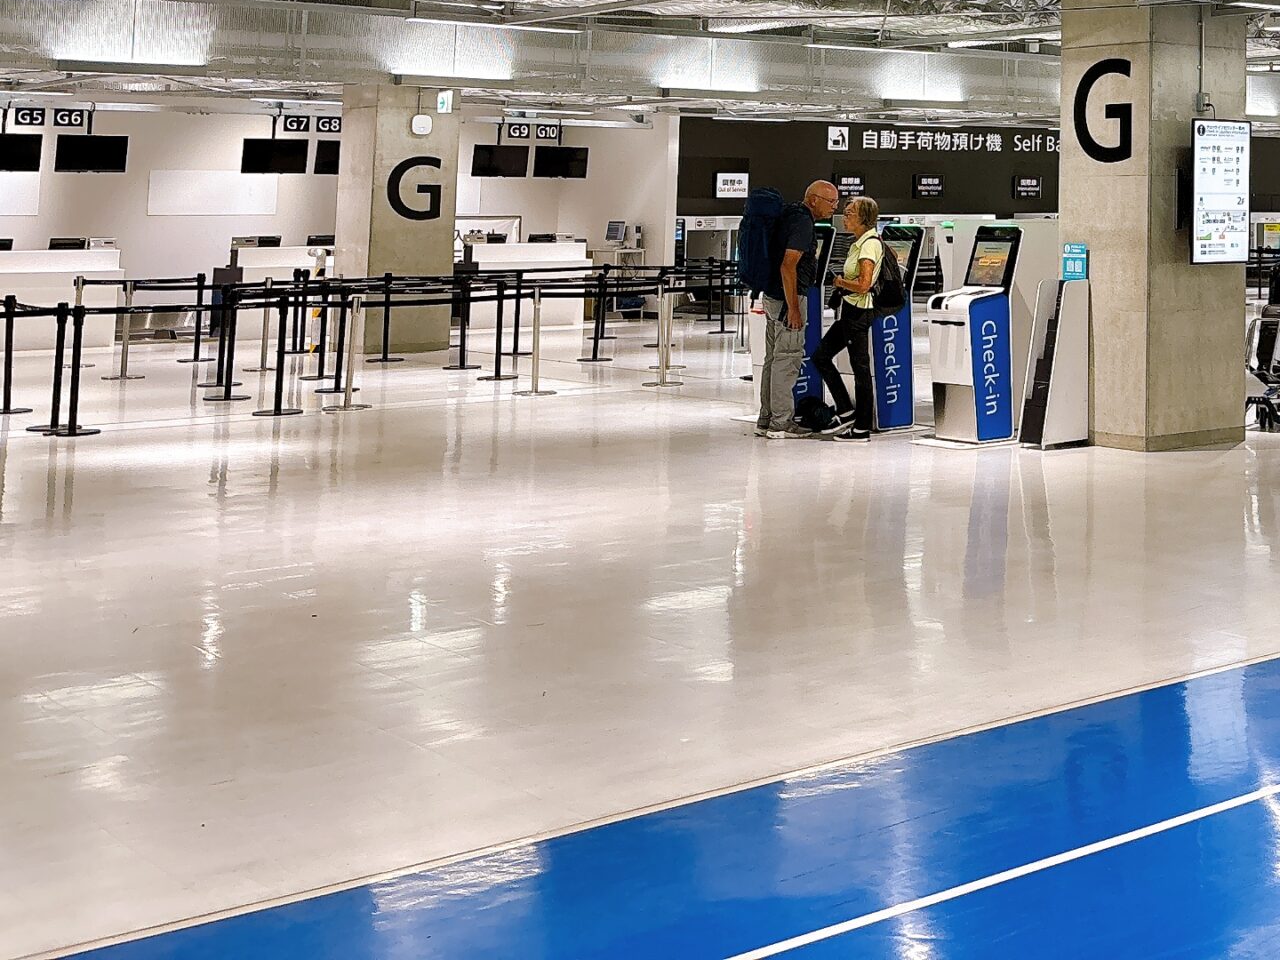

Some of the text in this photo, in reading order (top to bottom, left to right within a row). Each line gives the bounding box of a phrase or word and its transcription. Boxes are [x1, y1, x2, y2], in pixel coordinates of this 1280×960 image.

[17, 110, 42, 124] G5
[56, 111, 81, 125] G6
[1073, 58, 1133, 164] G
[286, 117, 307, 130] G7
[318, 118, 340, 131] G8
[510, 125, 529, 137] G9
[537, 125, 557, 138] G10
[862, 129, 1061, 152] 自動手荷物預け機 Self Ba
[387, 156, 442, 221] G
[882, 314, 902, 405] Check-in
[981, 320, 1000, 416] Check-in
